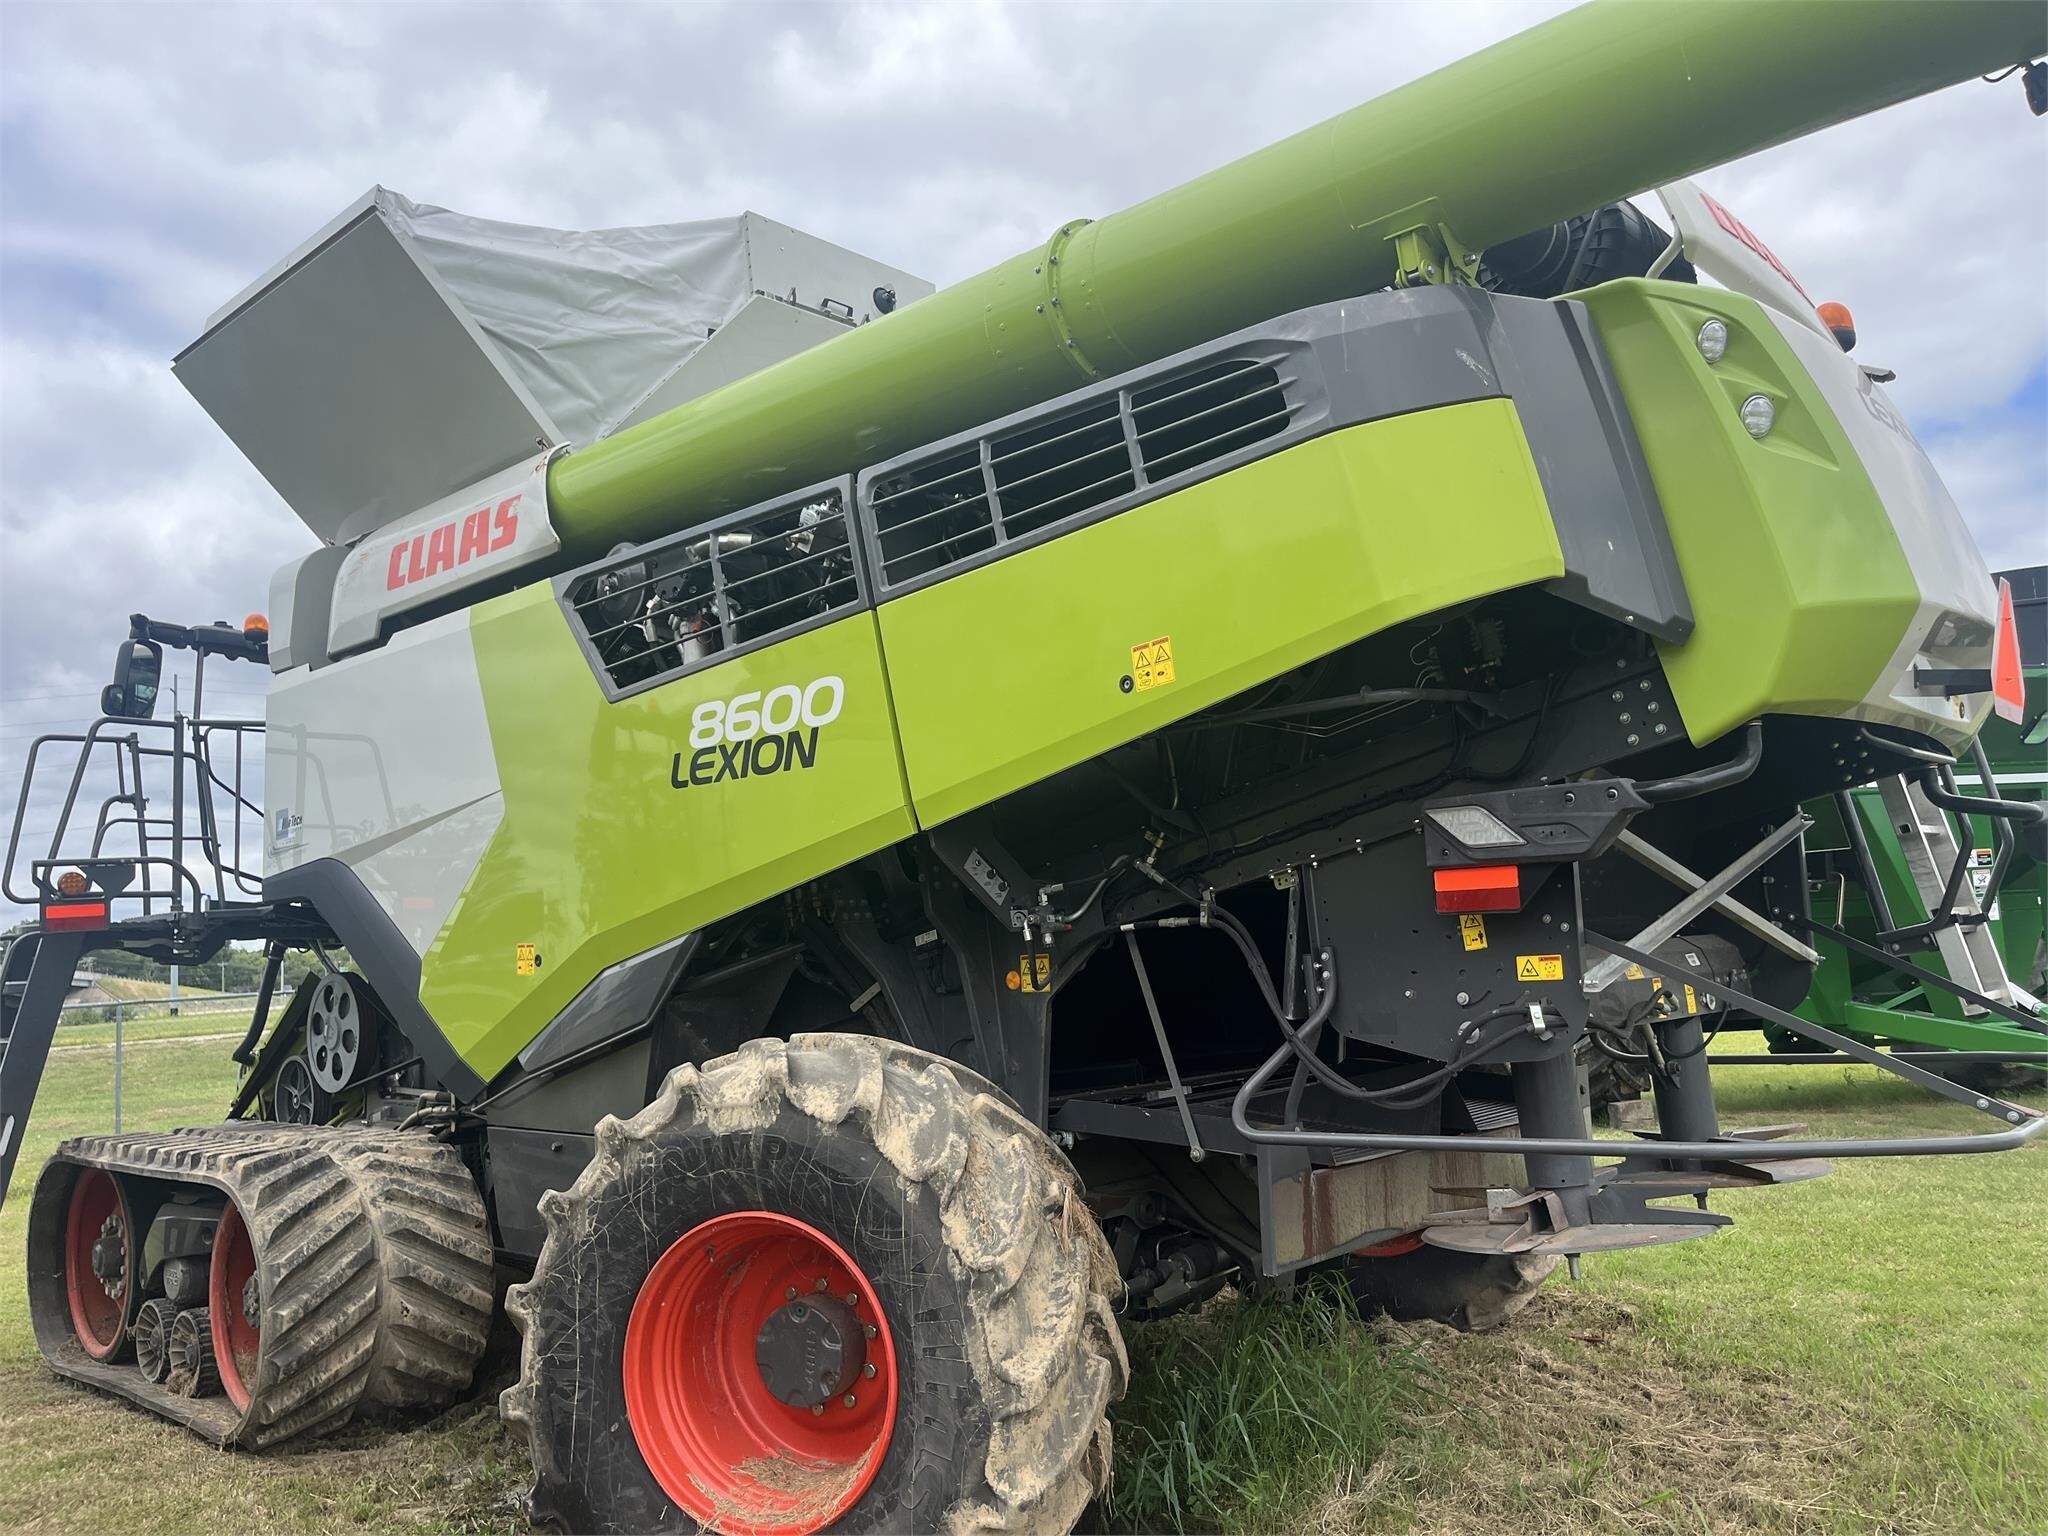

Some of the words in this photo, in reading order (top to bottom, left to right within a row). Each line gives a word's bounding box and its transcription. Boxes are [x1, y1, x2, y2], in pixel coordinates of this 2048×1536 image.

[387, 494, 522, 591] CLAAS
[689, 676, 844, 749] 8600
[671, 727, 819, 789] LEXION
